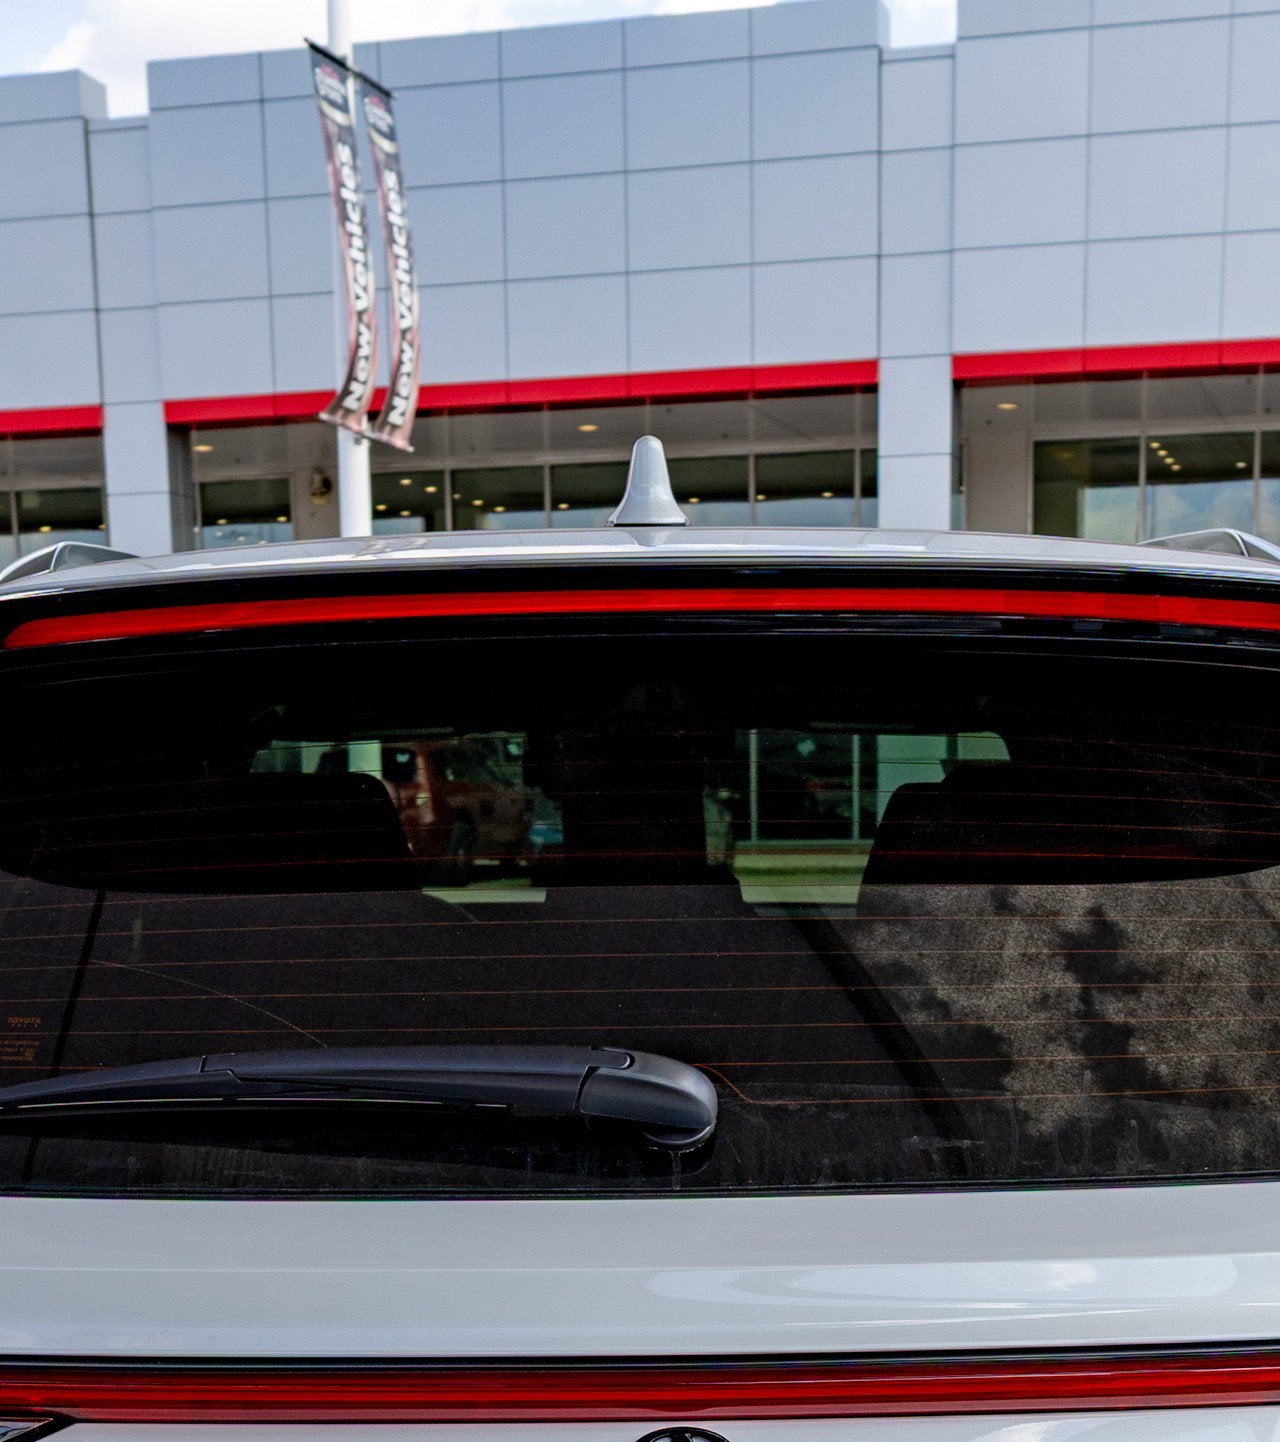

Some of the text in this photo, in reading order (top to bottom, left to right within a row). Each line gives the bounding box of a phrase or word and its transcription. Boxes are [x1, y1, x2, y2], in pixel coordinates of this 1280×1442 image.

[337, 142, 370, 411] New Vehicles
[383, 168, 413, 426] New Vehicles
